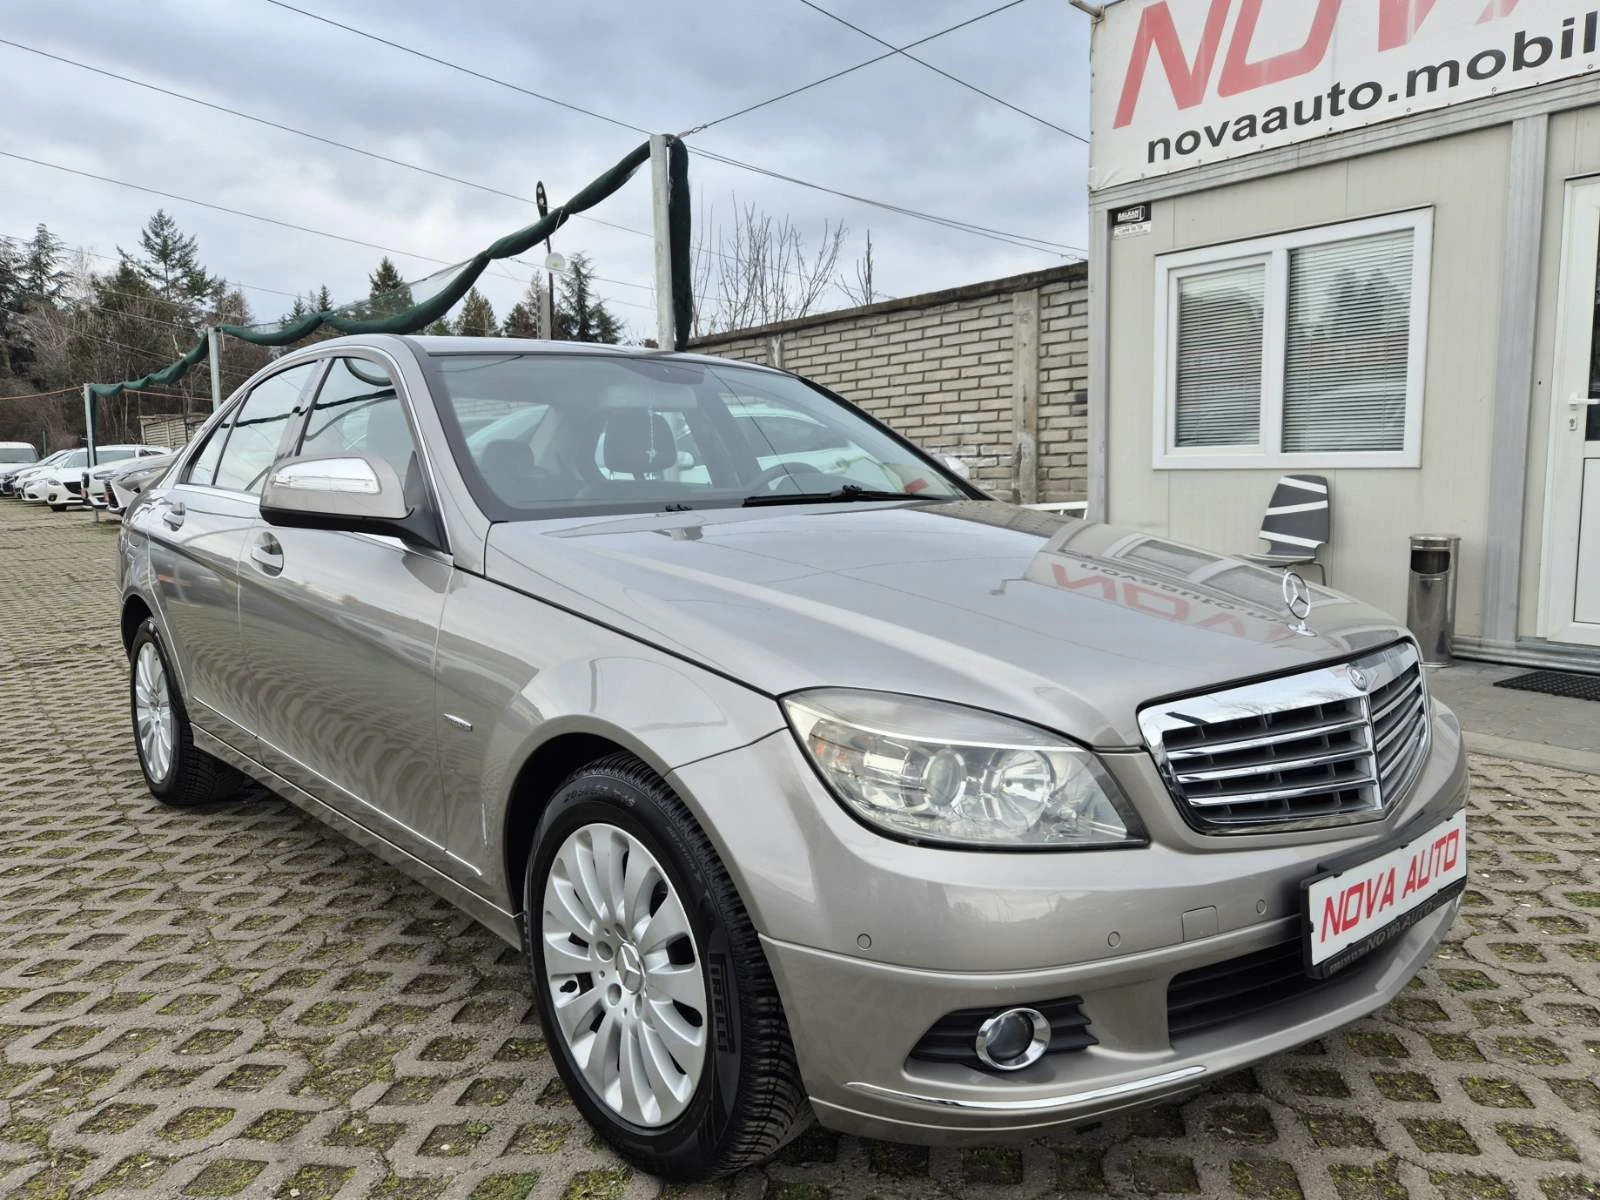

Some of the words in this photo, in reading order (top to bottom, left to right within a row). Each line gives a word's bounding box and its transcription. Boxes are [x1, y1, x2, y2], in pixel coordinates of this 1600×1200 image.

[1113, 0, 1520, 129] NO
[1147, 10, 1598, 164] novaauto.mobil
[1320, 867, 1396, 943] NOVA
[1402, 828, 1460, 900] AUTO
[708, 953, 736, 1054] PIRELLI
